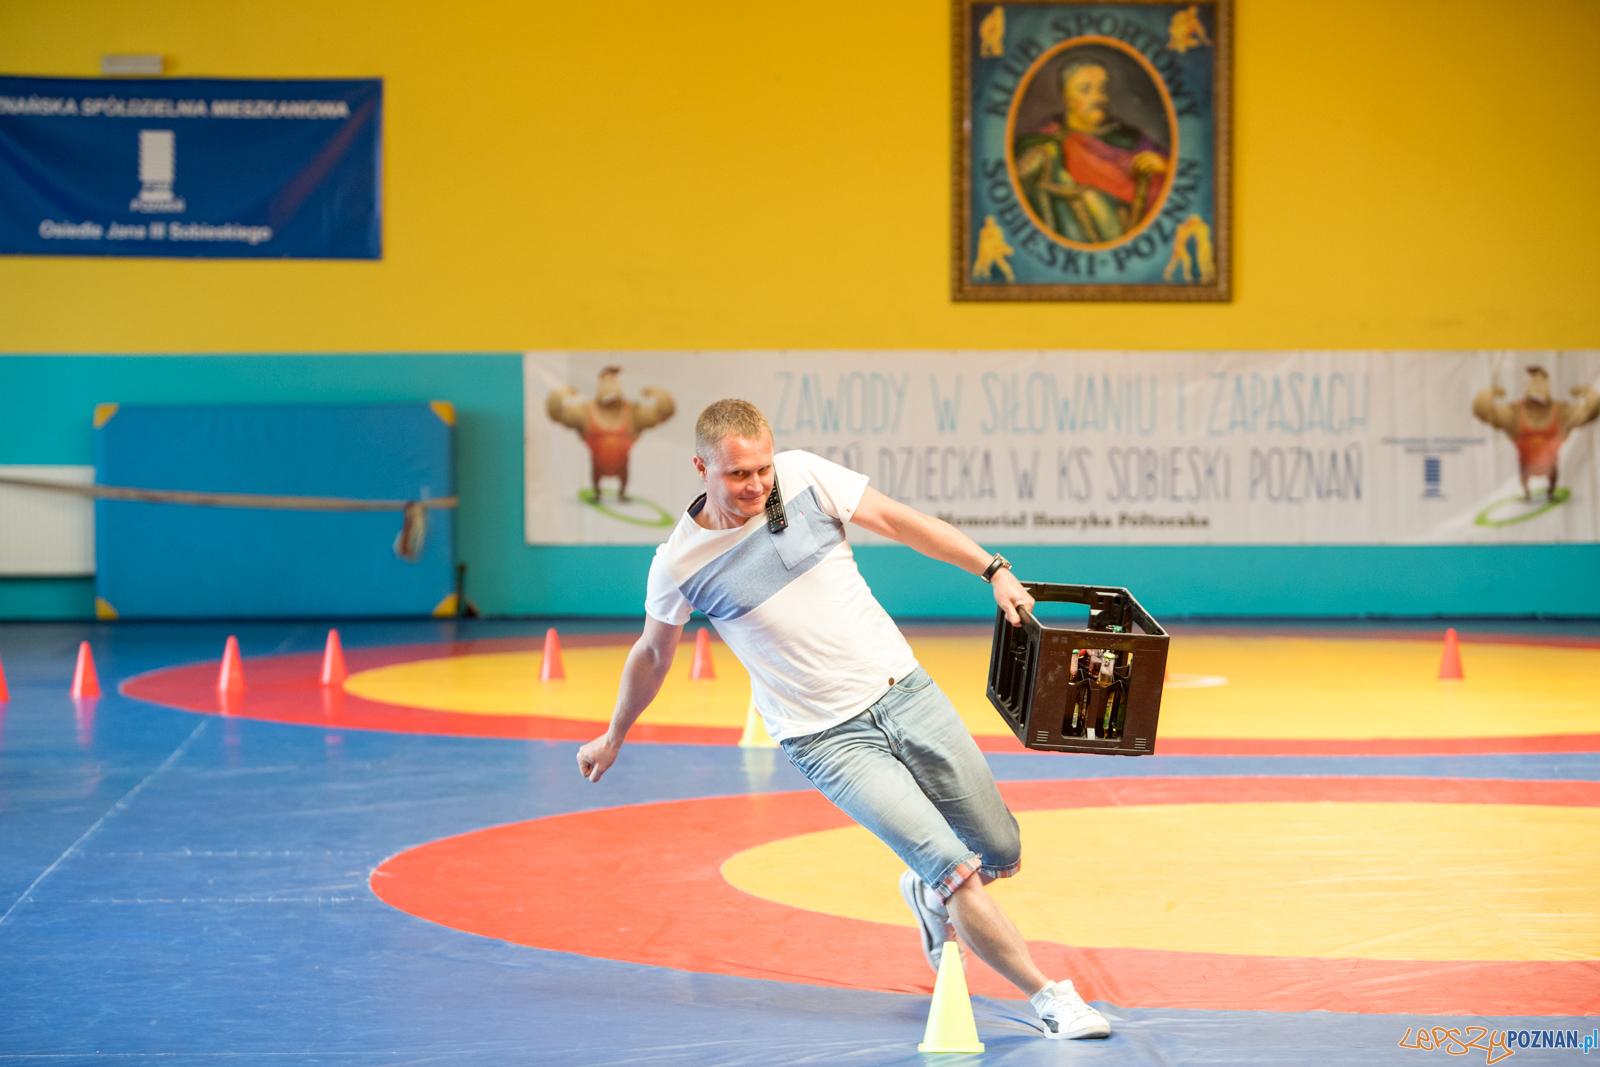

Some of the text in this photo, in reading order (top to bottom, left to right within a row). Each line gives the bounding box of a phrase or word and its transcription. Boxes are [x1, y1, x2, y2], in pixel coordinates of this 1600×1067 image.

[0, 94, 78, 115] NAŃSKA
[39, 219, 103, 239] Osiedle
[106, 221, 147, 240] Jana
[169, 221, 272, 245] Sobieskiego
[774, 371, 908, 436] ZAWODY
[929, 372, 963, 433] W
[1207, 371, 1369, 436] ZAPASACH
[1010, 446, 1041, 500] W
[1057, 446, 1092, 500] KS
[1251, 442, 1363, 501] POZNAŃ
